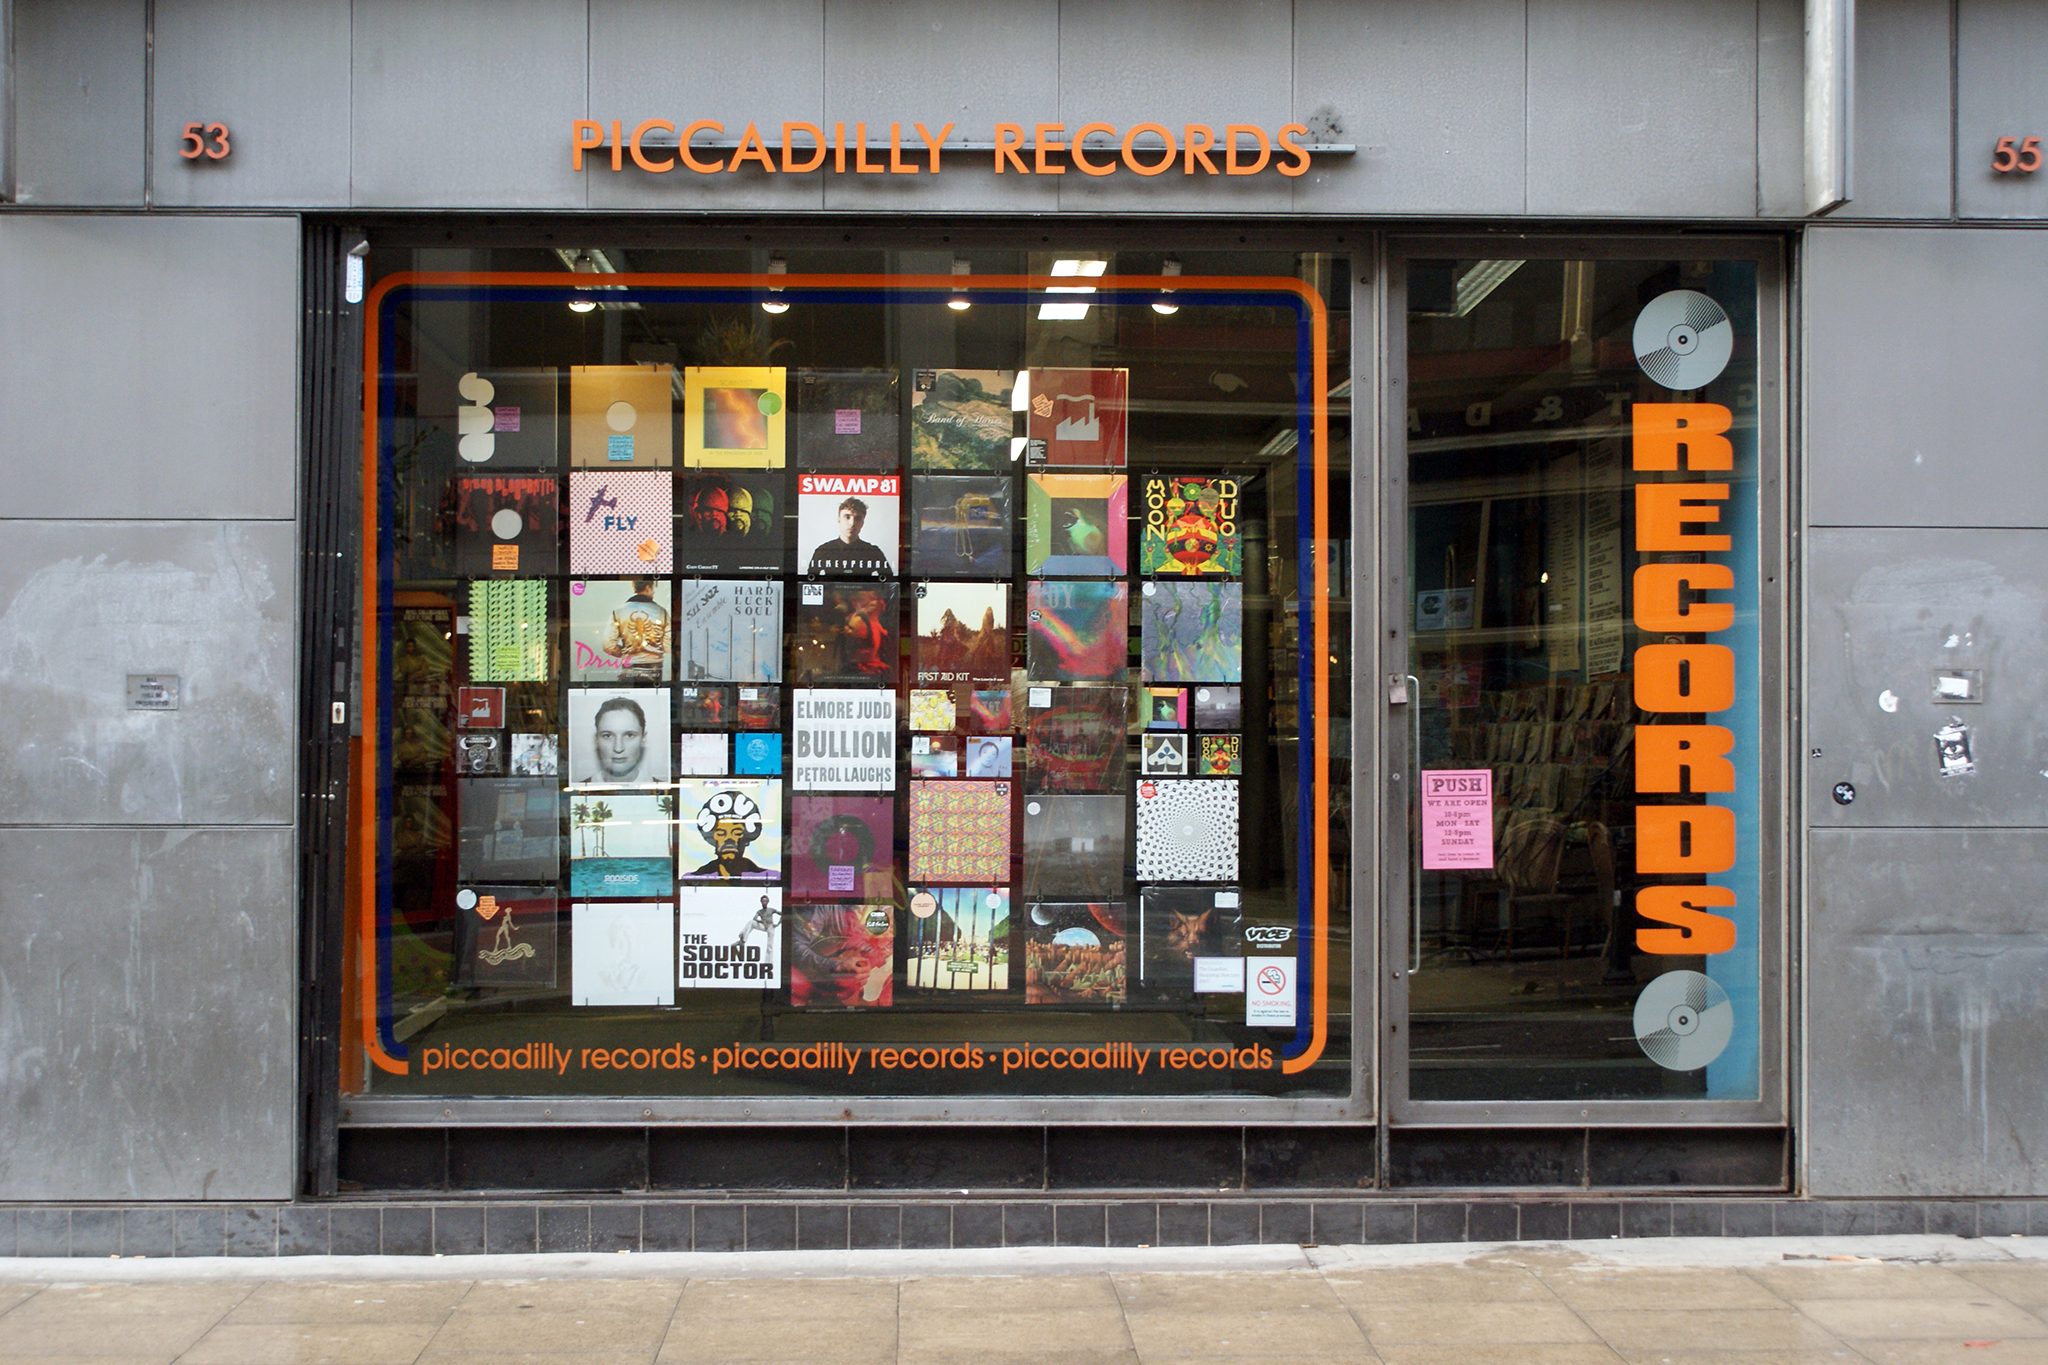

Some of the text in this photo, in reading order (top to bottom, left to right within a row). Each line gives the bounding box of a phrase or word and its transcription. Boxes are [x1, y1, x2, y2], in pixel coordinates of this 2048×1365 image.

[179, 122, 230, 159] 53
[572, 118, 1312, 178] PICCADILLY RECORDS
[1991, 136, 2043, 173] 55
[922, 412, 957, 424] Band
[1145, 479, 1166, 541] MOON
[1219, 479, 1238, 536] DUO
[604, 516, 638, 531] FLY
[734, 586, 774, 596] HARD
[734, 596, 773, 606] LUCK
[734, 606, 772, 616] SOUL
[574, 640, 633, 669] Drive
[918, 672, 970, 681] FIRST AID KIT
[1632, 403, 1736, 954] RECORDS
[797, 701, 892, 719] ELMORE JUDD
[797, 730, 892, 758] BULLION
[797, 767, 892, 782] PETROL LAUGHS
[1432, 778, 1482, 792] PUSH
[683, 934, 708, 945] THE
[1245, 926, 1293, 942] VICE
[683, 945, 761, 962] SOUND
[683, 962, 774, 980] DOCTOR
[423, 1041, 1273, 1075] piccadilly records piccadilly records piccadilly records
